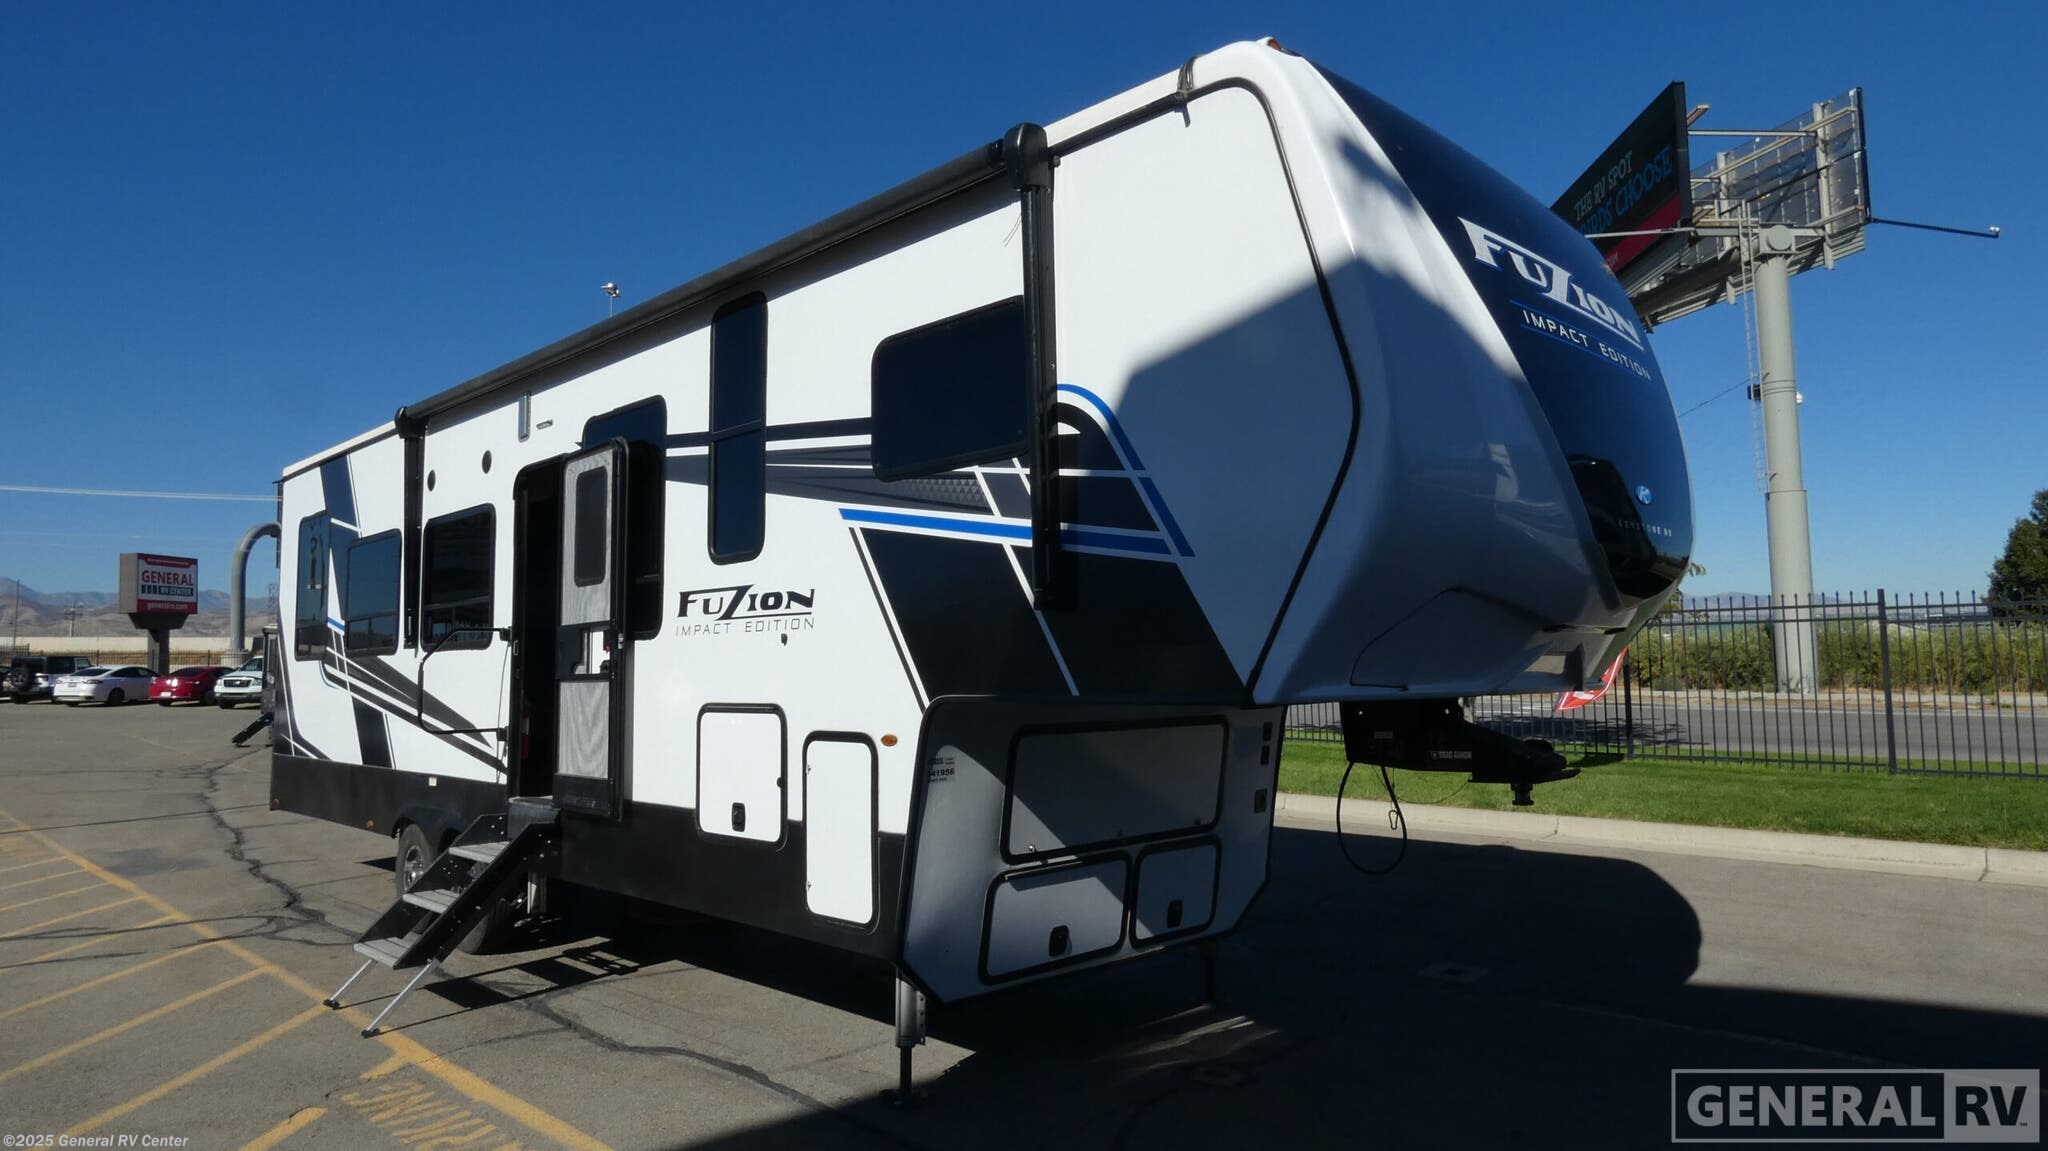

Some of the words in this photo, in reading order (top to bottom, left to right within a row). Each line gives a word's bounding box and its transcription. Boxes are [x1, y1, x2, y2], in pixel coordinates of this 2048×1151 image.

[1574, 189, 1593, 221] THE
[1593, 176, 1606, 206] RV
[1608, 151, 1632, 189] SPOT
[1615, 144, 1674, 217] CHOOSE
[1457, 216, 1645, 351] FUZION
[1522, 310, 1590, 348] IMPACT
[1598, 342, 1652, 381] EDITION
[142, 570, 193, 586] GENERAL
[677, 583, 816, 621] FUZION
[675, 622, 732, 637] IMPACT
[745, 617, 815, 633] EDITION
